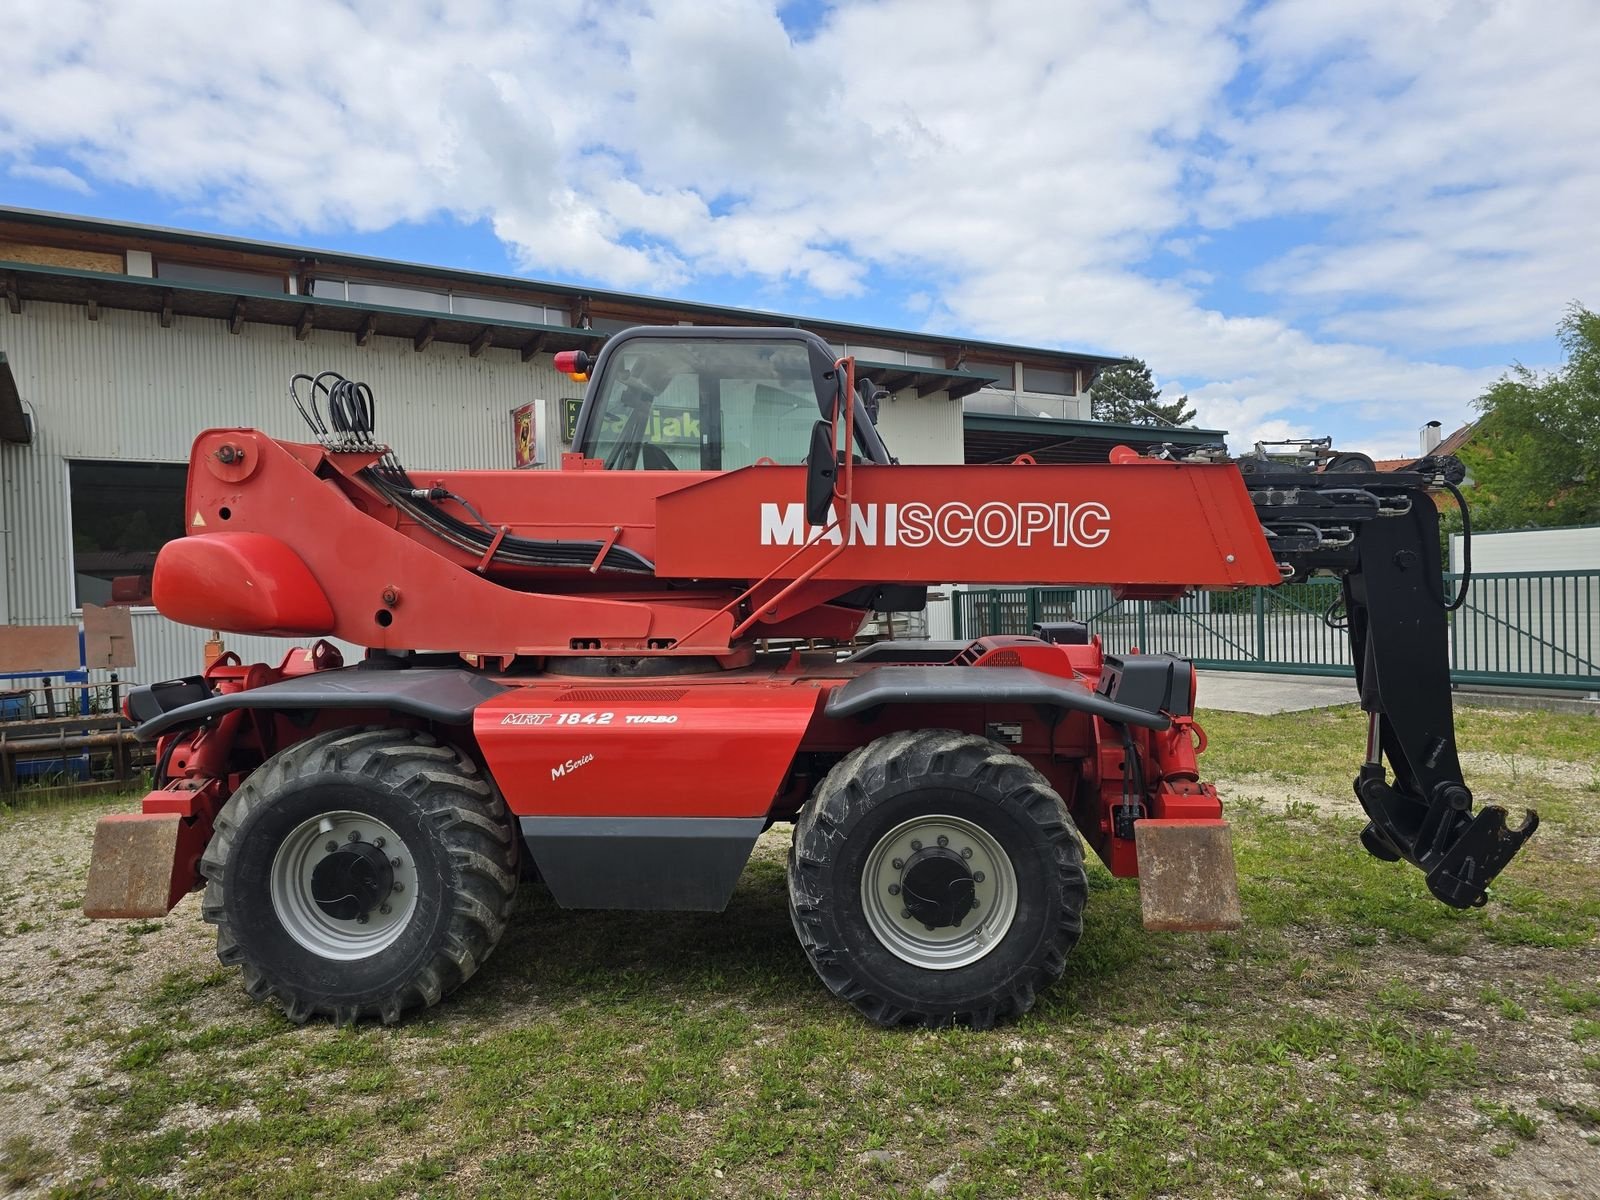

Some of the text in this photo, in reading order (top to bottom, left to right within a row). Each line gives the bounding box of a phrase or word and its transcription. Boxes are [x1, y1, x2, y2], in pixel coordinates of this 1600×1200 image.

[760, 502, 1111, 548] MANISCOPIC
[500, 712, 679, 725] MRT 1842 TURBO
